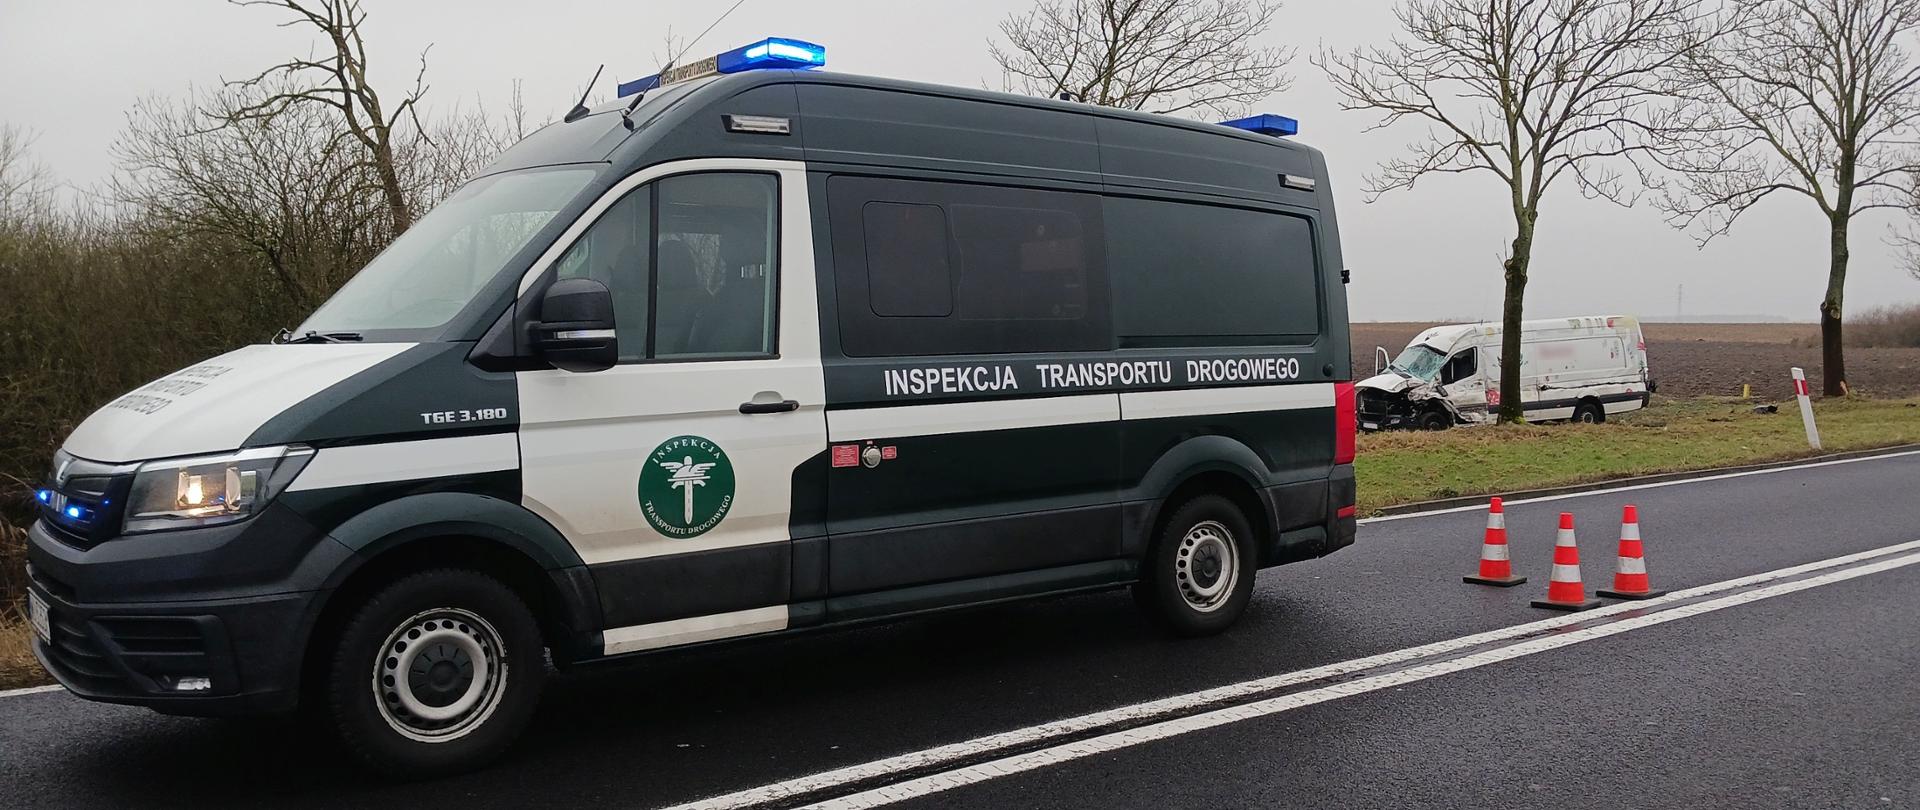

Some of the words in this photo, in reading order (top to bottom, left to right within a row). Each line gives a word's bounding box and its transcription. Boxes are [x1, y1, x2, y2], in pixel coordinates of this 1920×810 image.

[884, 365, 1019, 396] INSPEKCJA
[1036, 360, 1172, 388] TRANSPORTU
[1186, 357, 1300, 383] DROGOWEGO
[420, 411, 456, 425] TGE
[459, 407, 507, 422] 3.180
[652, 438, 721, 464] INSPEKCJA
[645, 500, 687, 535] TRANSPORTU
[687, 494, 731, 534] DROGOWEGO
